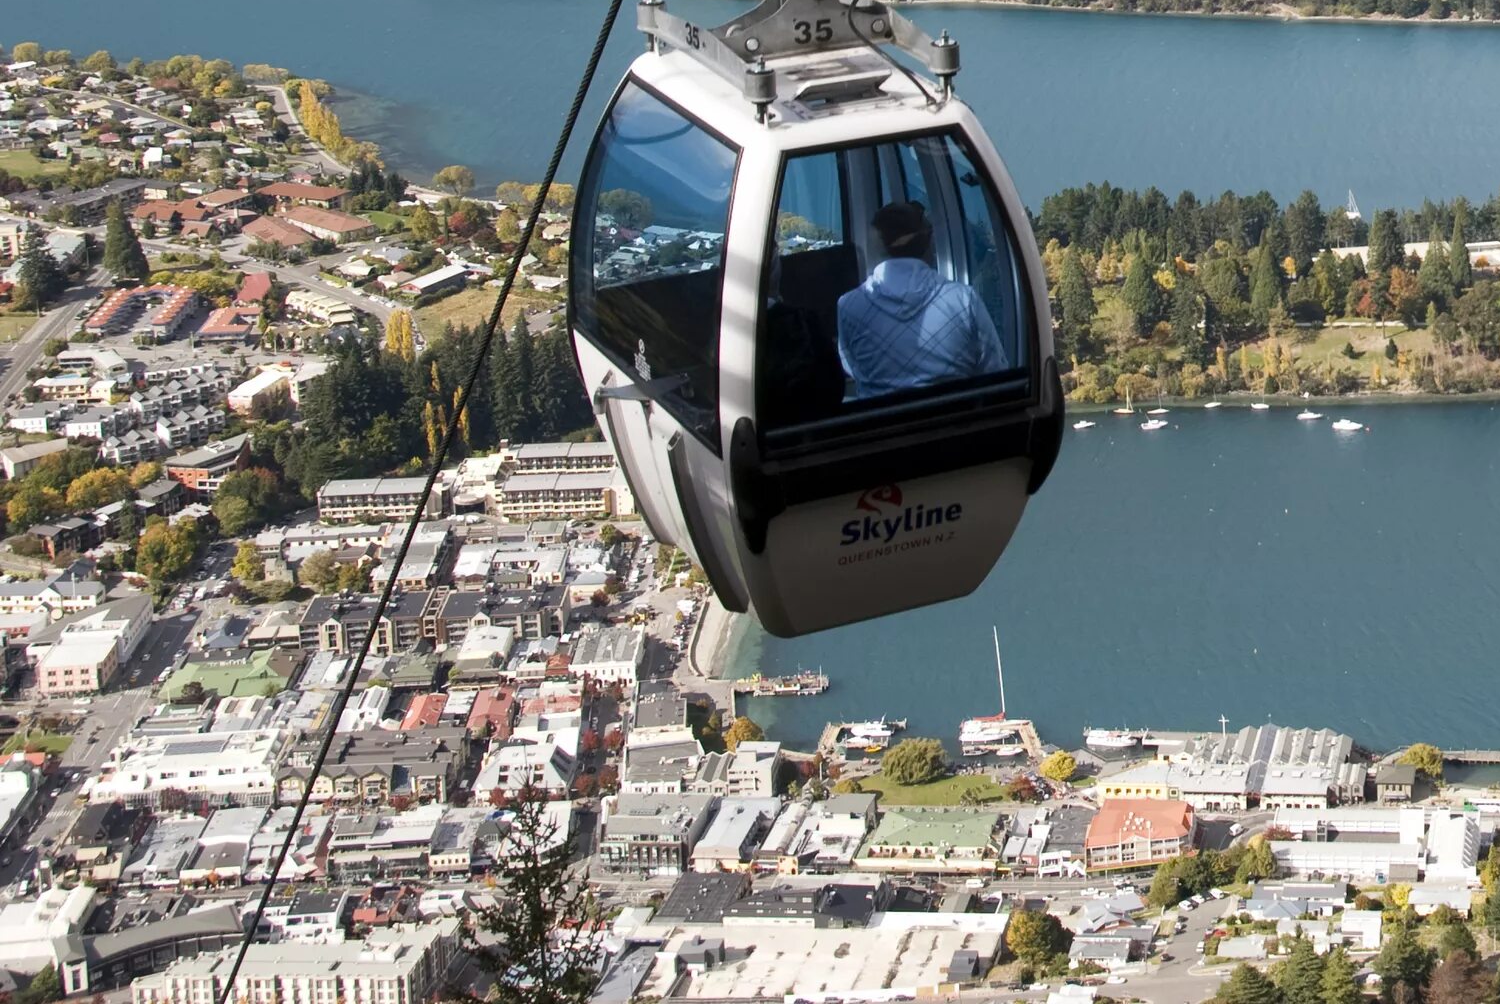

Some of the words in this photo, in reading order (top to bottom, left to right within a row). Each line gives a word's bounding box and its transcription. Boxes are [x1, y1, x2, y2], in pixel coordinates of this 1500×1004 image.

[685, 22, 700, 50] 35
[794, 19, 833, 44] 35
[840, 503, 962, 546] Skyline
[838, 537, 930, 565] QUEENSTOWN
